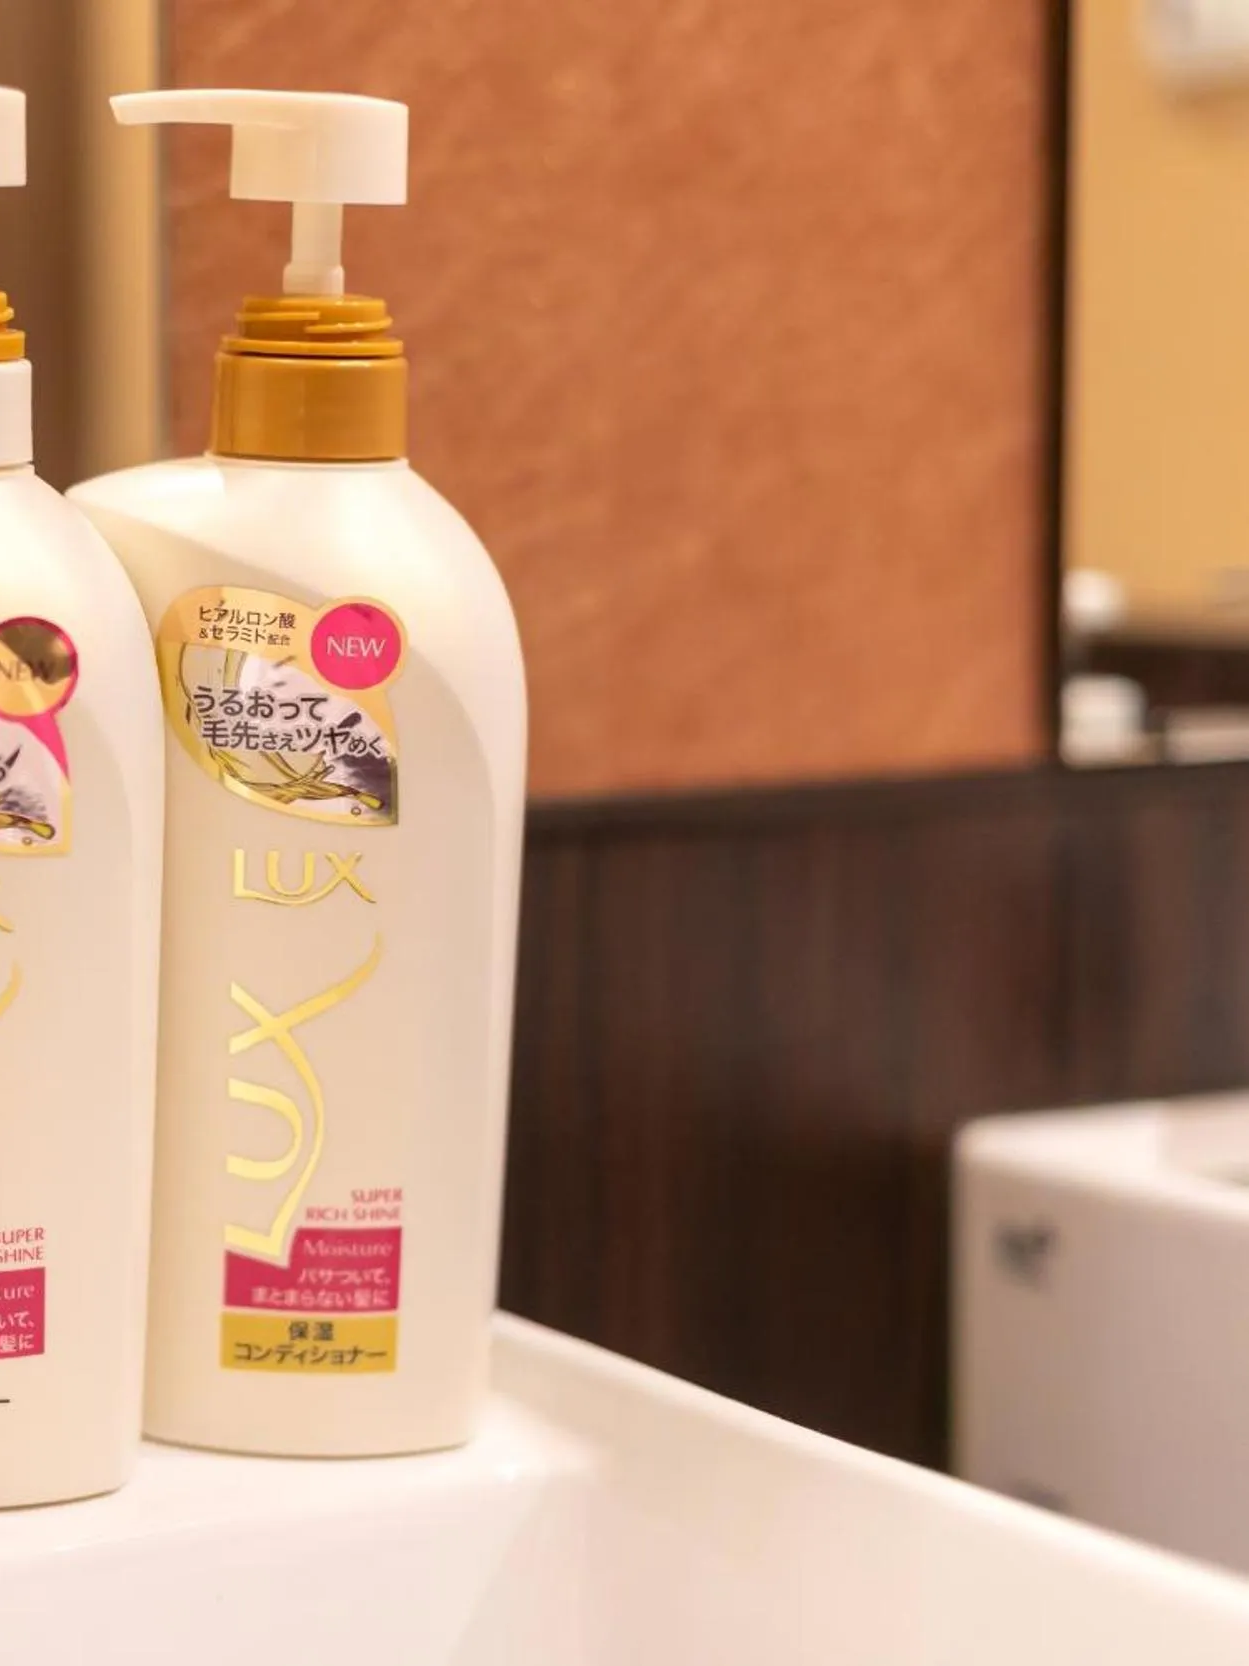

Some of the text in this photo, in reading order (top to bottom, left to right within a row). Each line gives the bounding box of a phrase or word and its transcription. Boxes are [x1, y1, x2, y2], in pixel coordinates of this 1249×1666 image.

[199, 605, 296, 629] ヒアルロン酸
[326, 634, 387, 659] NEW
[193, 685, 329, 721] うるおって
[202, 718, 383, 756] 毛先さえツヤめく
[233, 848, 377, 905] LUX
[225, 930, 384, 1257] LUX
[351, 1187, 403, 1204] SUPER
[305, 1206, 401, 1221] RICH SHINE
[303, 1238, 393, 1258] Moisture
[233, 1342, 388, 1365] コンディショナー
